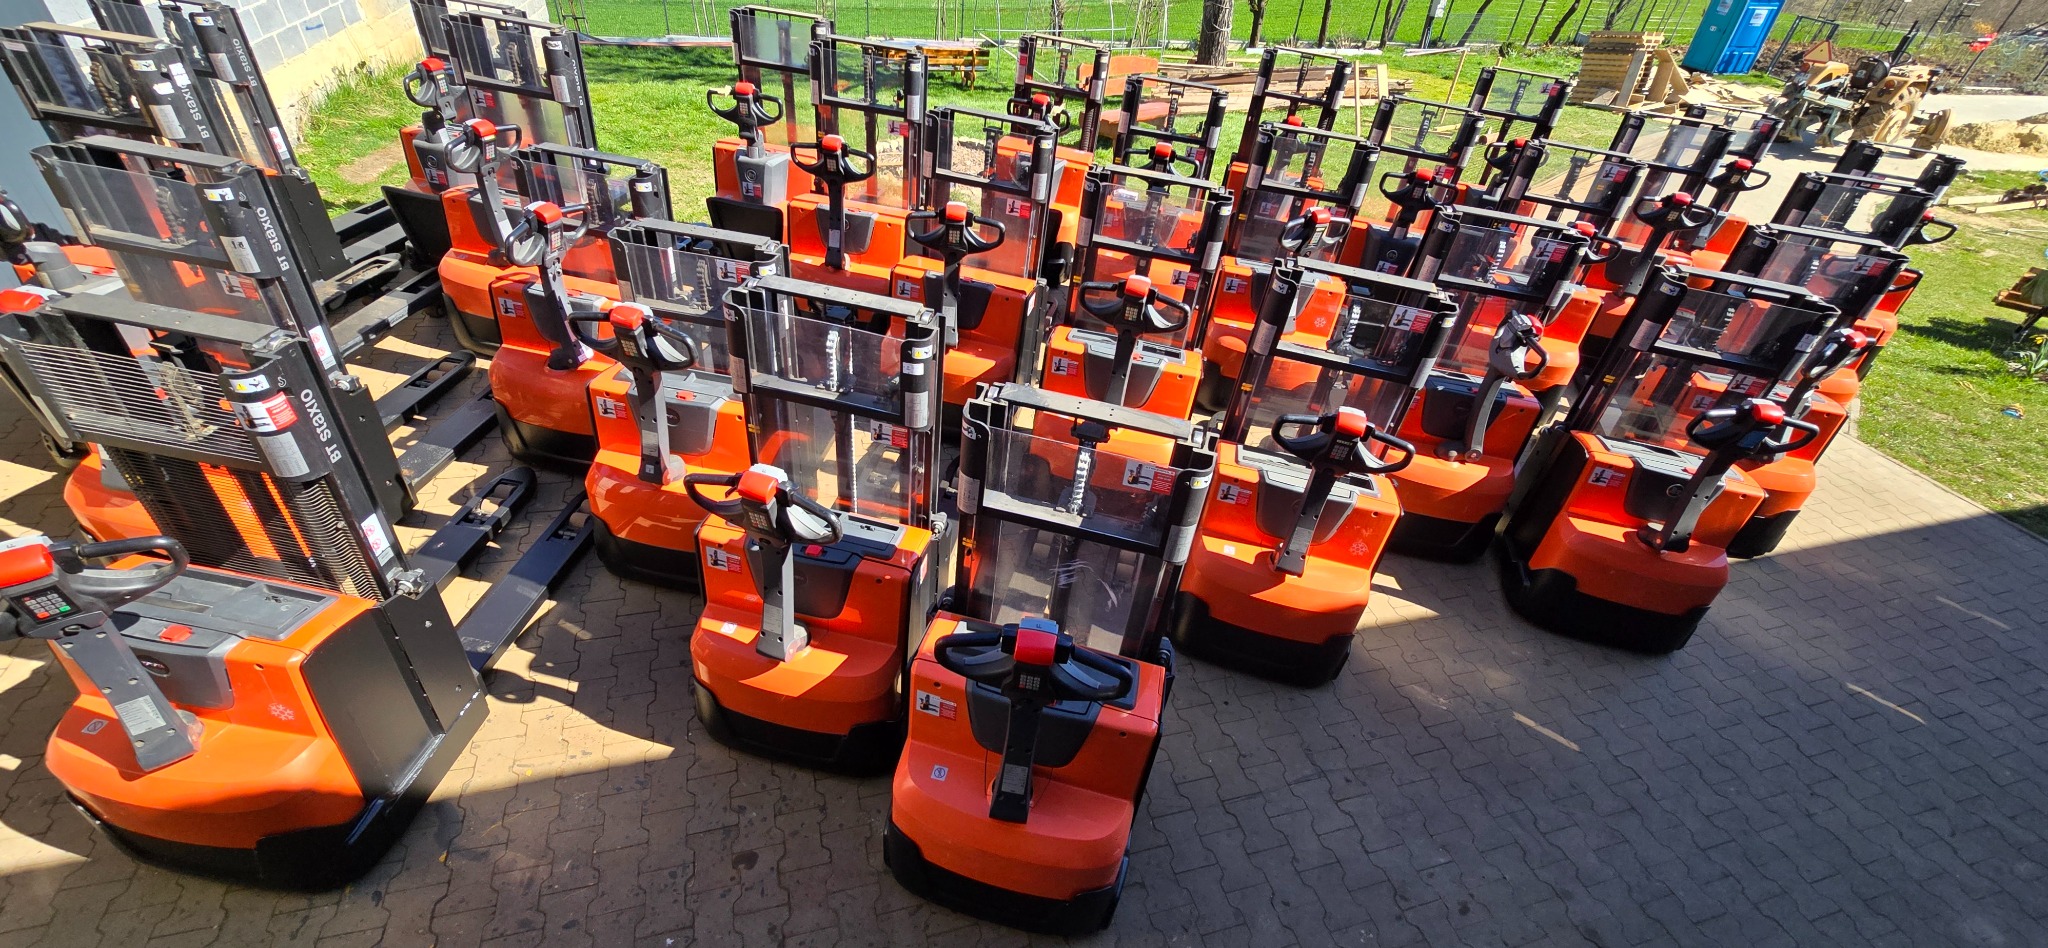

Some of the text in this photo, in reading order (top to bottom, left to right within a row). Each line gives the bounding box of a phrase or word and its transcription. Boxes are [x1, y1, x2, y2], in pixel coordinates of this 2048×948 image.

[247, 75, 258, 87] BT
[197, 124, 210, 138] BT
[277, 255, 290, 271] BT
[325, 443, 342, 464] BT
